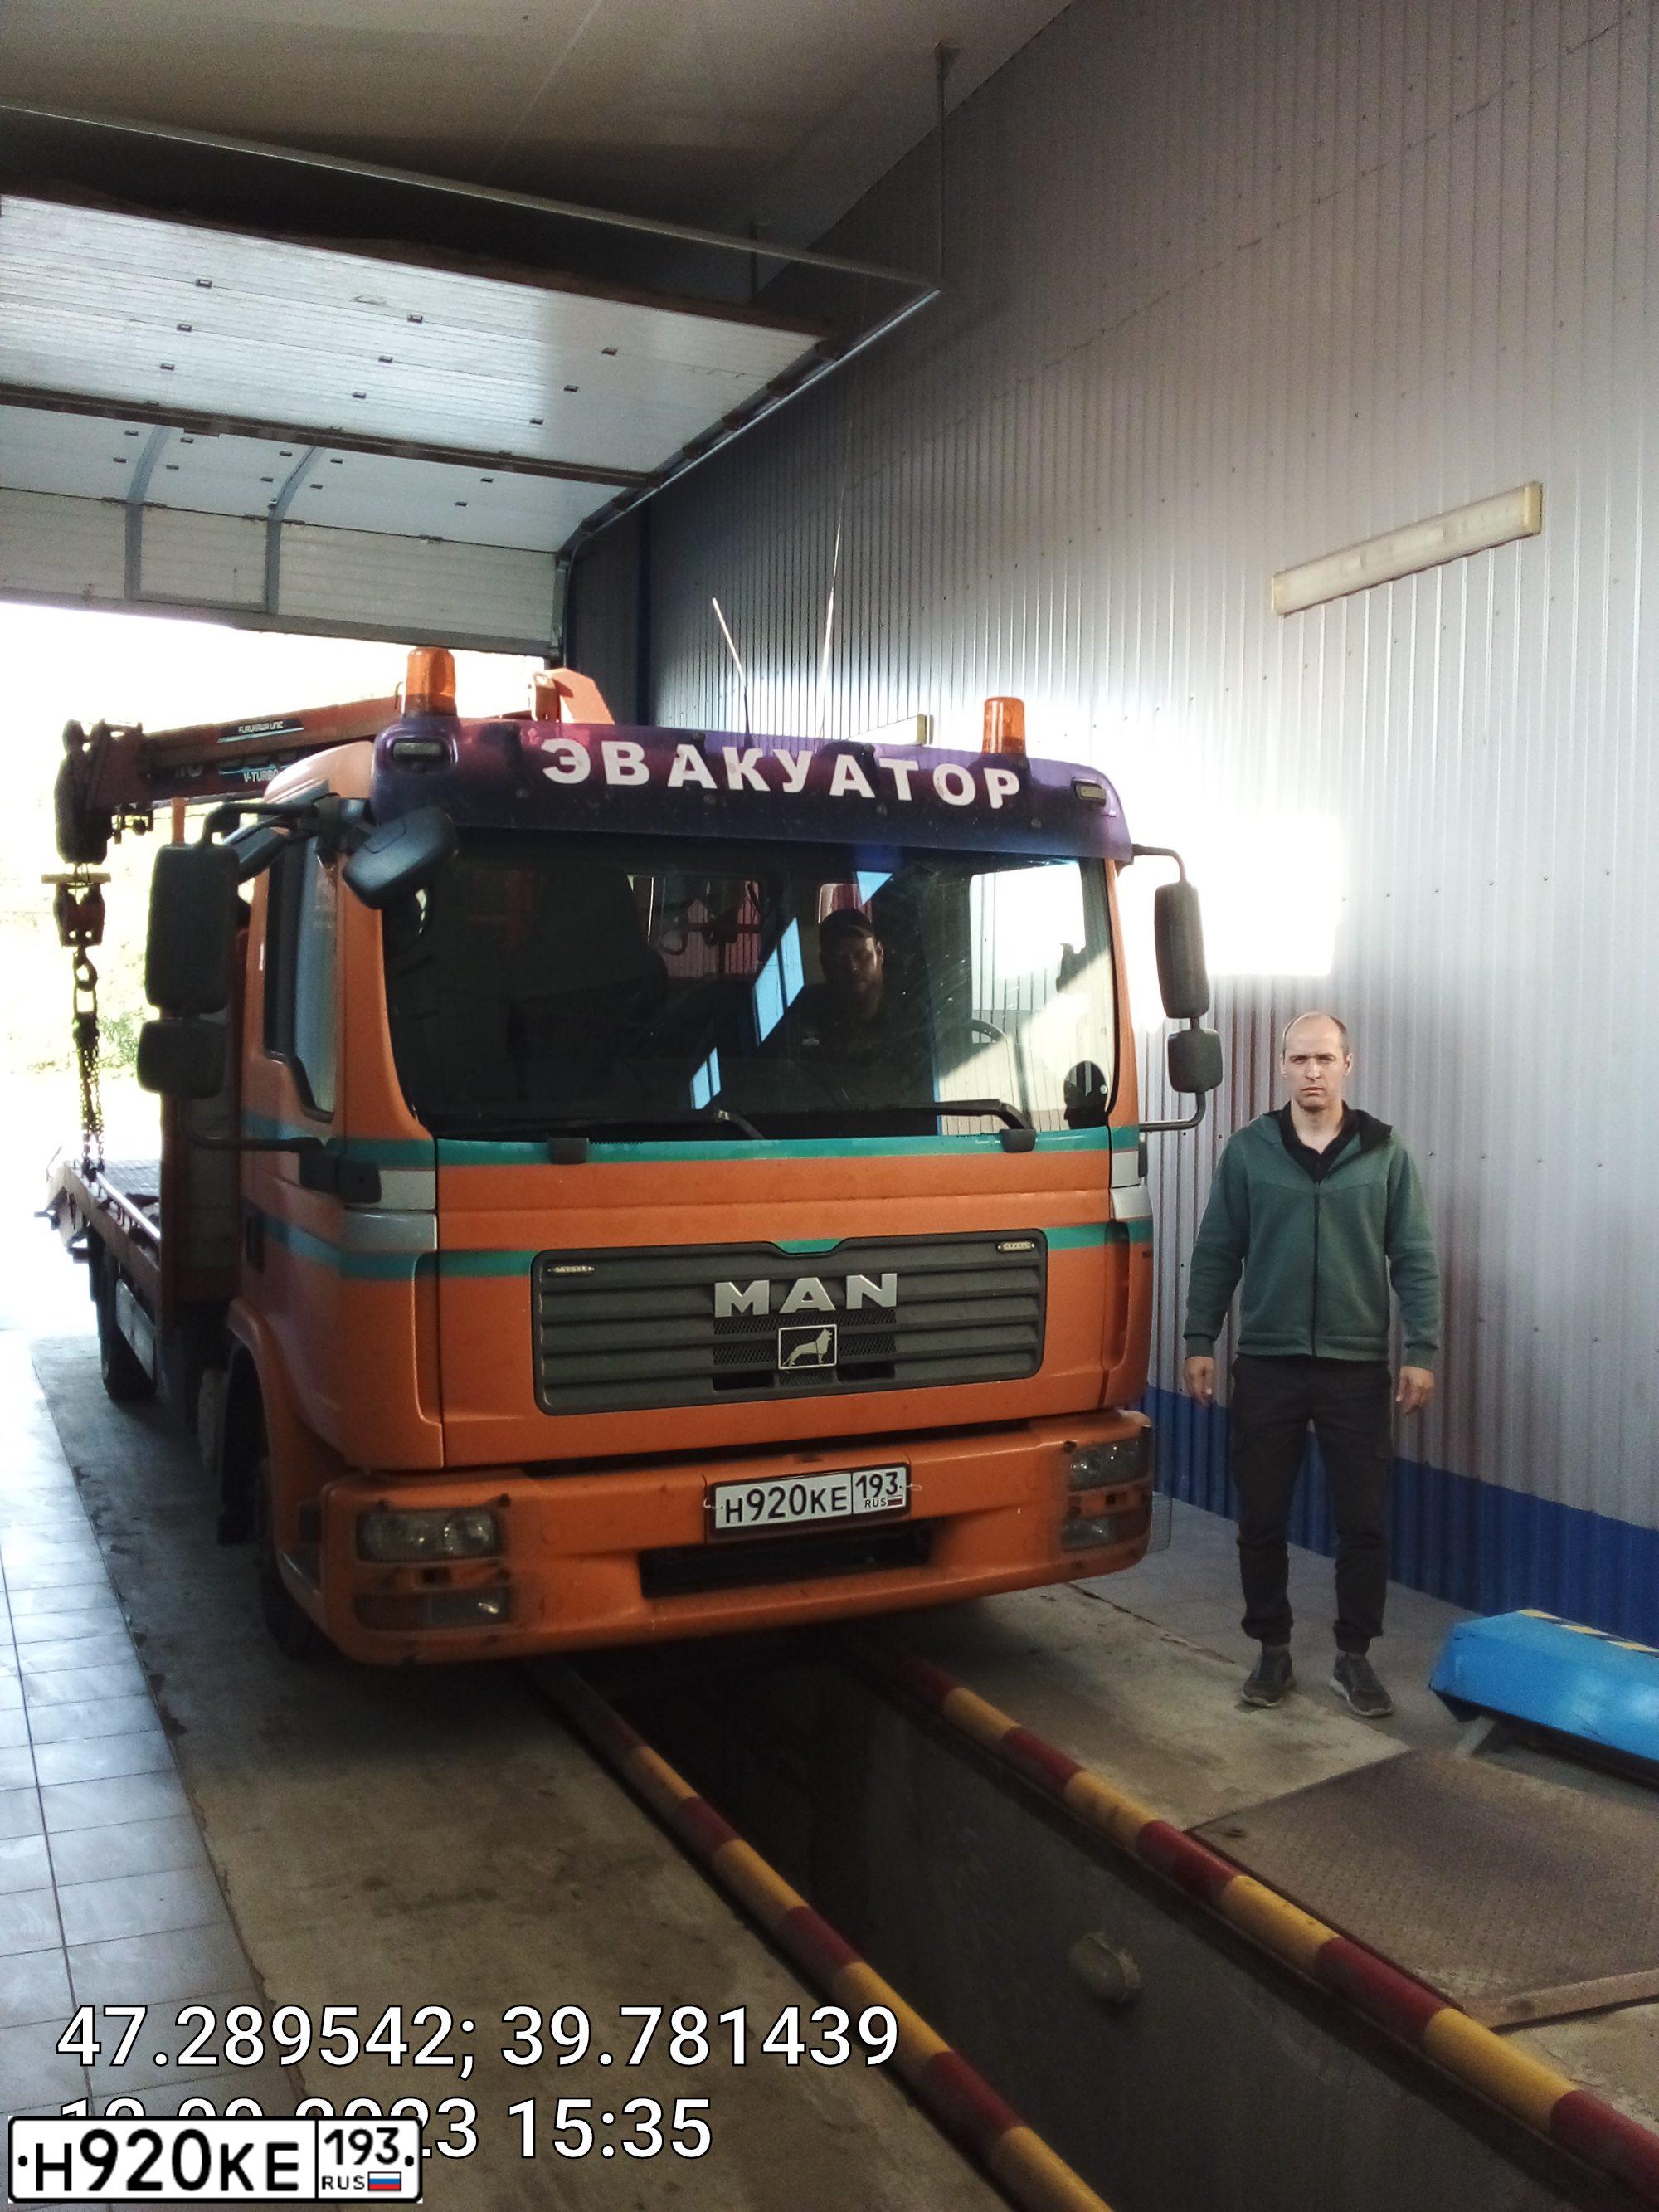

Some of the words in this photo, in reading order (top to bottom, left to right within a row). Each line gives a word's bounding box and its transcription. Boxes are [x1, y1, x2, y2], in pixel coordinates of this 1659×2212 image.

[542, 737, 1021, 810] ЭВАКУАТОР
[713, 1273, 898, 1318] MAN
[725, 1484, 848, 1523] Н920КЕ
[855, 1471, 899, 1499] 193
[864, 1498, 887, 1508] RUS
